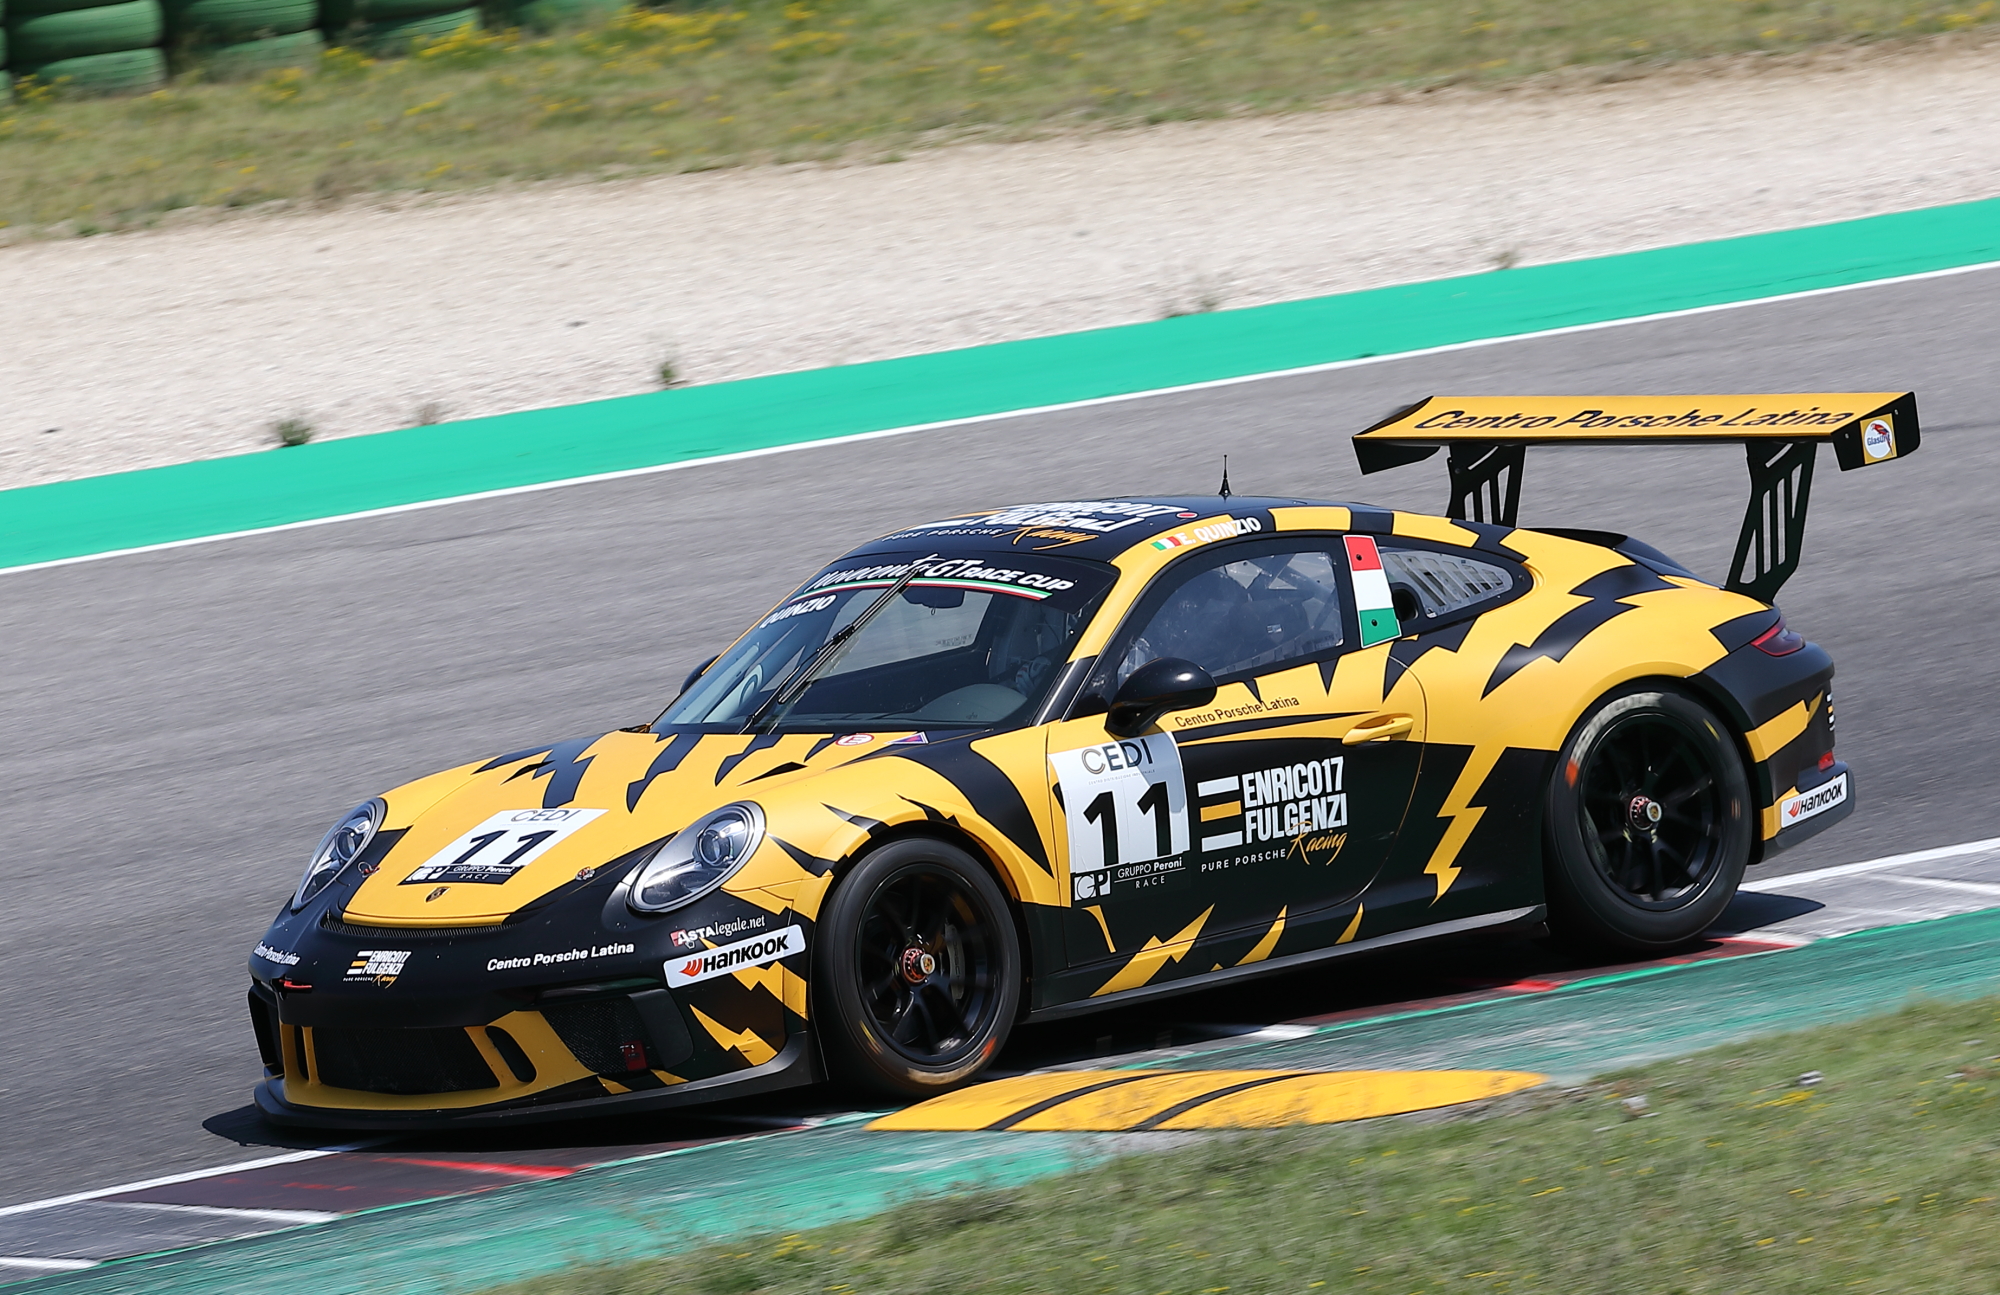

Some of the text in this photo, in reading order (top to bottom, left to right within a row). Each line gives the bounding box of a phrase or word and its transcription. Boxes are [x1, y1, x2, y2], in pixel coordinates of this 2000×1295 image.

[1414, 406, 1854, 429] Centro Porsche Latina
[927, 528, 1003, 536] PORSCHE
[1175, 516, 1262, 546] E. QUINZIO
[1017, 573, 1075, 590] CUP
[759, 594, 837, 629] QUINZIO
[1174, 696, 1300, 728] Centro Porsche Latina
[1081, 738, 1154, 775] CEDI
[1241, 756, 1344, 808] ENRICO17
[511, 809, 582, 822] CEDI
[1083, 780, 1172, 868] 11
[1245, 792, 1348, 844] FULGENZI
[450, 829, 559, 865] 11
[1285, 820, 1348, 866] Racing
[453, 865, 486, 873] GRUPPO
[1117, 856, 1183, 879] GRUPPO Peroni
[1201, 848, 1286, 873] PURE PORSCHE
[1135, 875, 1165, 889] RACE
[361, 962, 404, 975] FULGENZI
[368, 950, 412, 963] ENRICO17
[487, 943, 634, 971] Centro Porsche Latina
